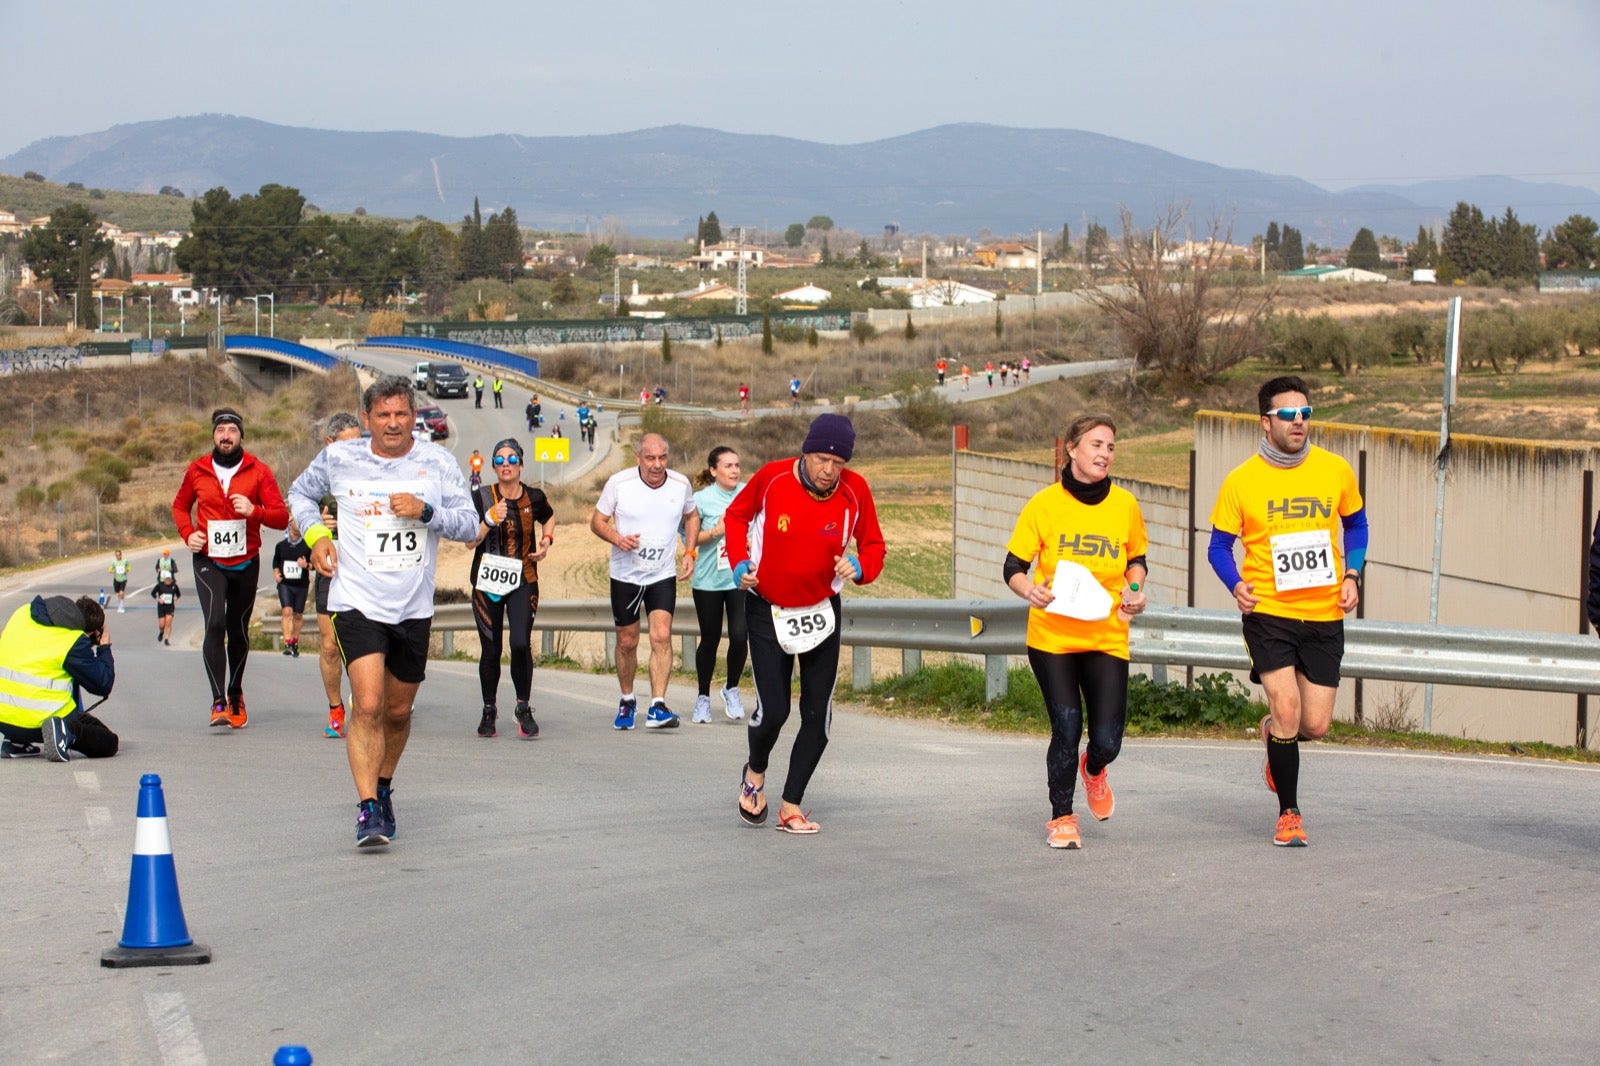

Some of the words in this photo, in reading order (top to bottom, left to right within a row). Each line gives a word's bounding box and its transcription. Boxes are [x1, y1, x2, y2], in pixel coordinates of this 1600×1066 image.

[1267, 496, 1333, 521] HSN
[214, 531, 239, 545] 841
[376, 531, 418, 553] 713
[1057, 533, 1120, 559] HSN
[638, 547, 665, 561] 427
[1277, 548, 1329, 573] 3081
[286, 566, 299, 574] 331
[481, 566, 518, 586] 3090
[786, 613, 827, 637] 359
